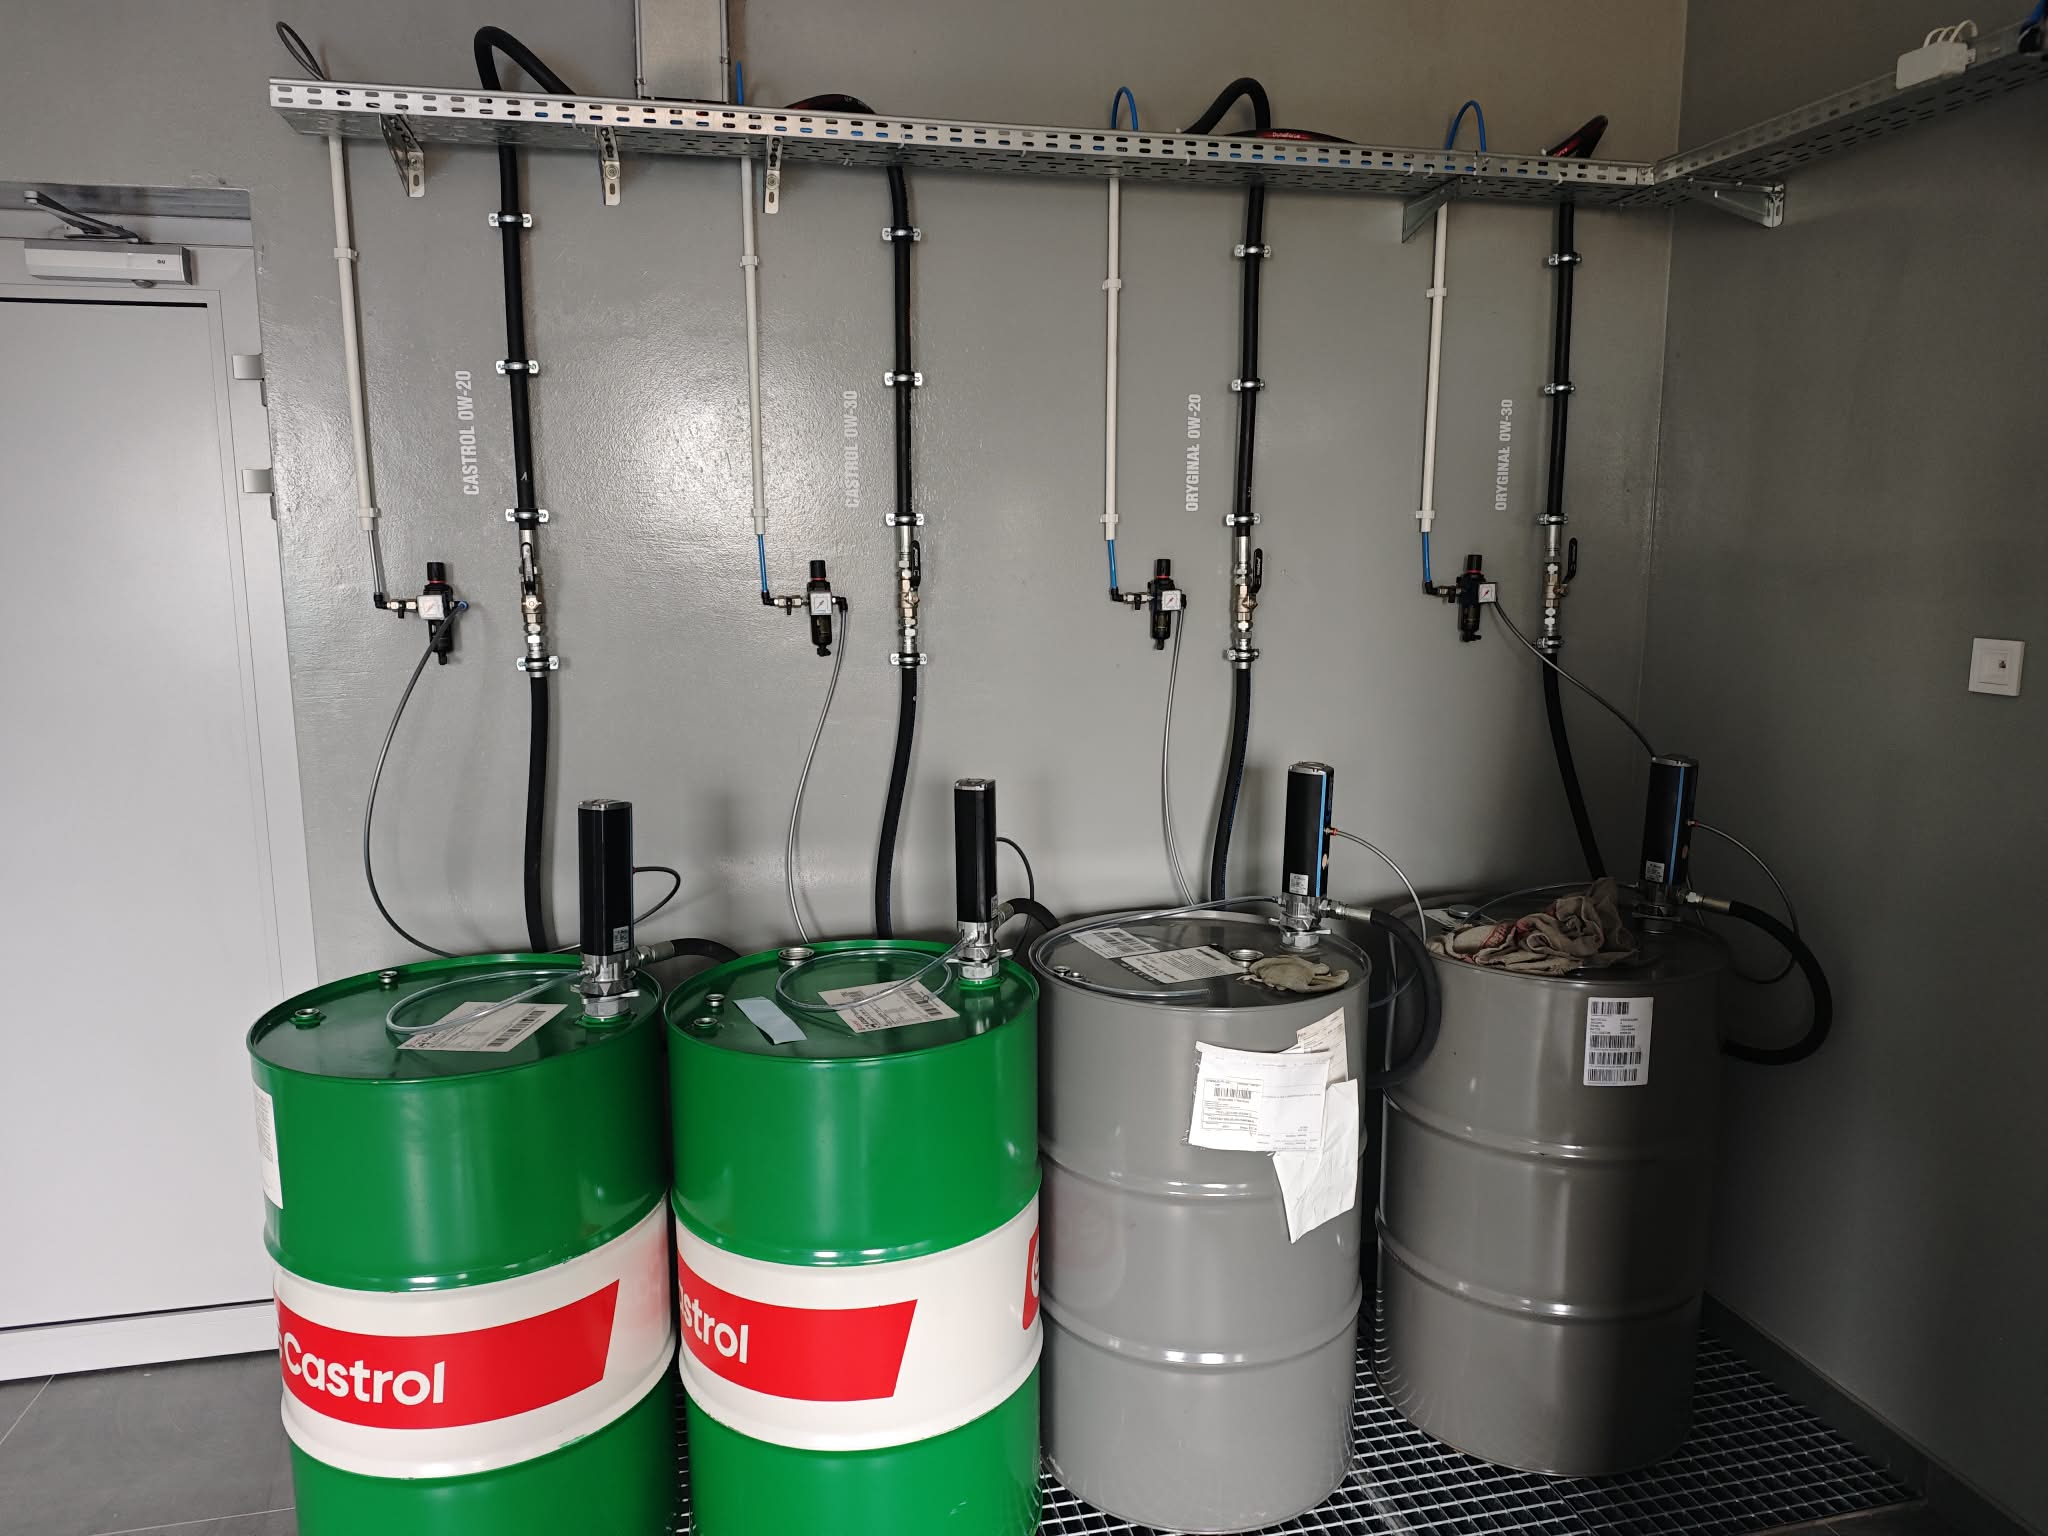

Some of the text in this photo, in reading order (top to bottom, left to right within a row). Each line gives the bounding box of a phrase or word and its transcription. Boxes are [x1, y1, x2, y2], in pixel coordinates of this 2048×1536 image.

[459, 425, 479, 495] CASTROL
[843, 442, 860, 508] CASTROL
[1185, 443, 1200, 512] ORYGINAŁ
[1494, 446, 1511, 511] ORYGINAŁ
[284, 1332, 445, 1406] Castrol
